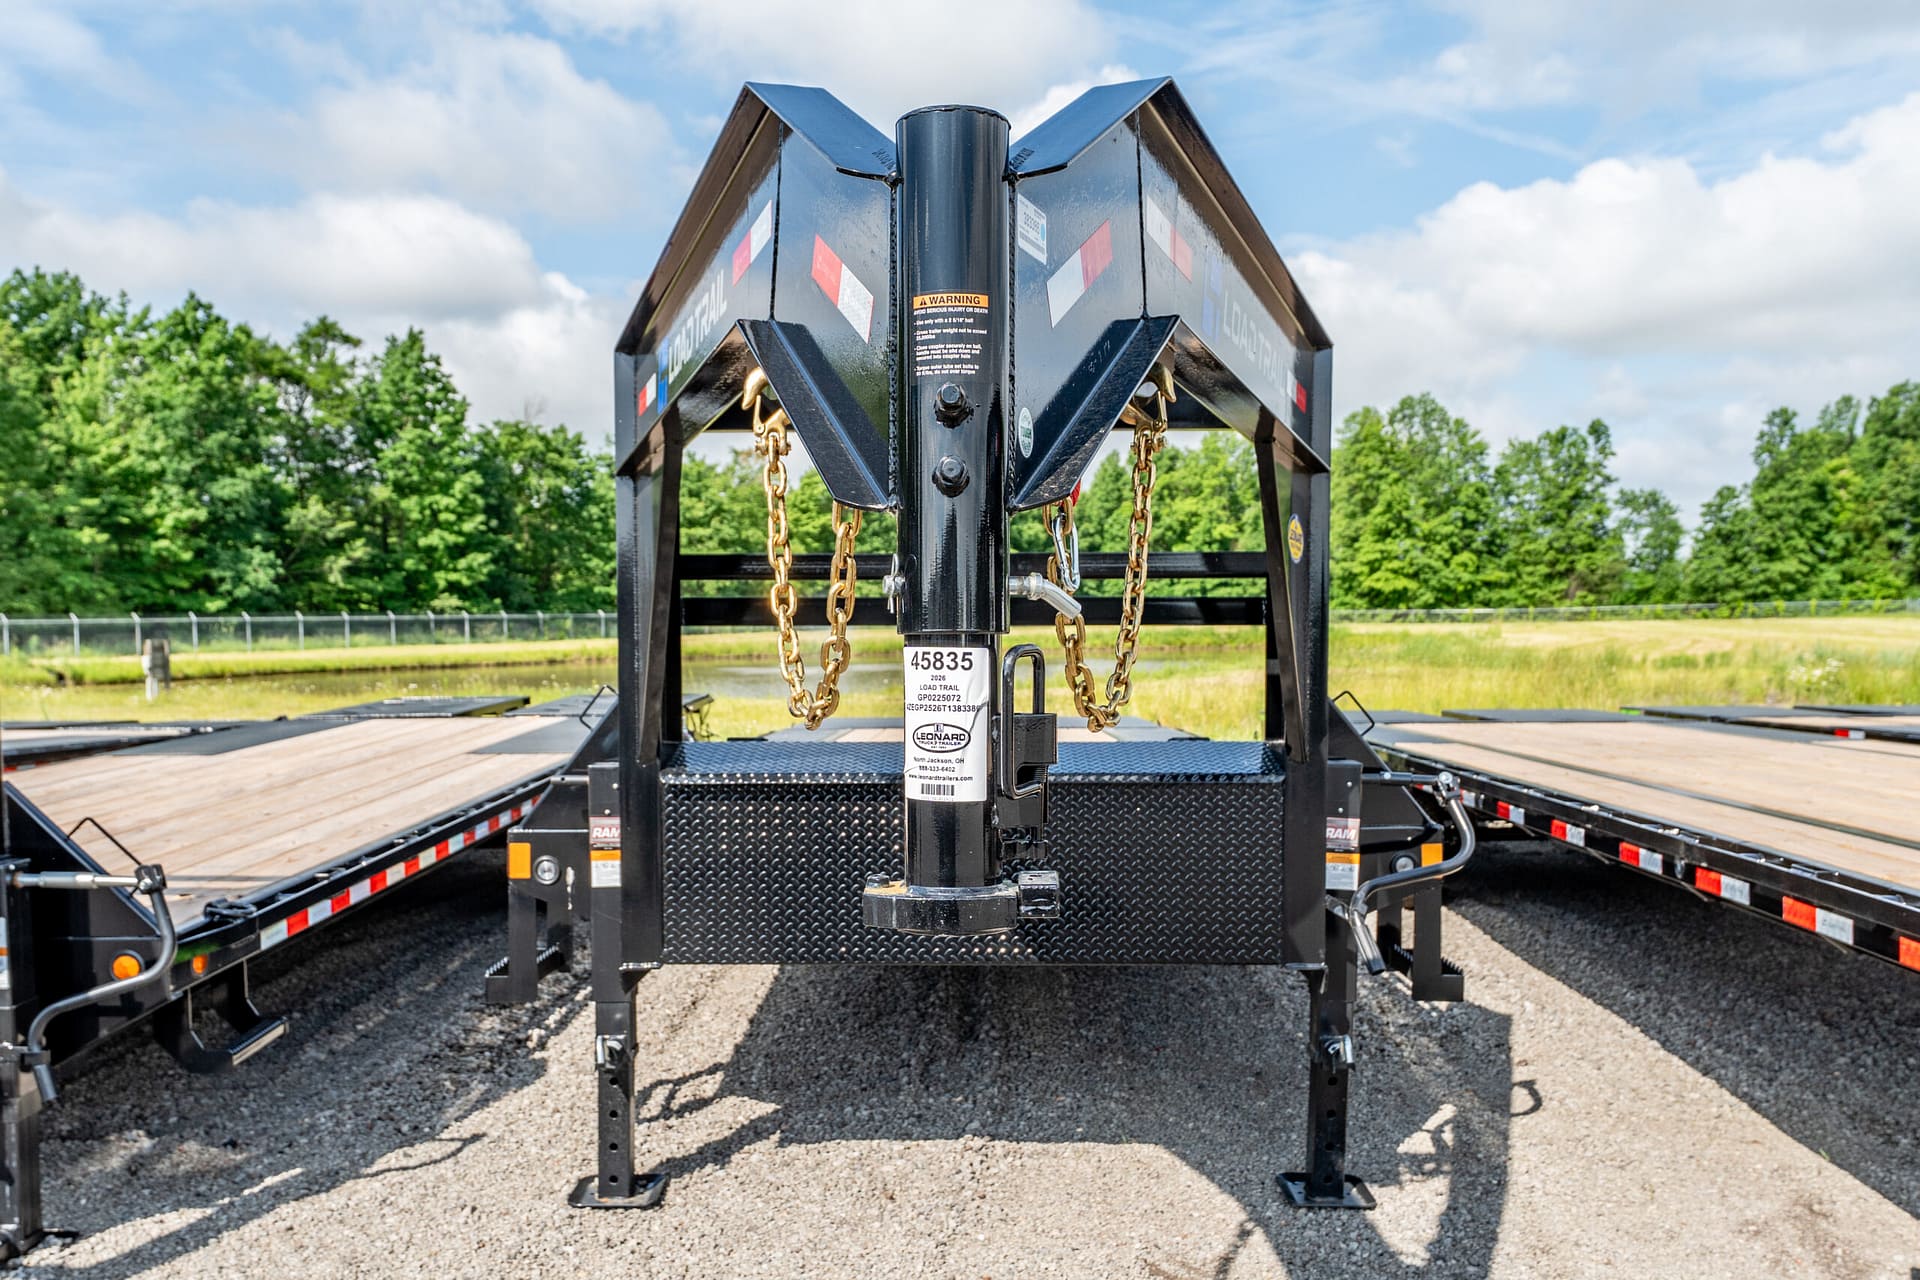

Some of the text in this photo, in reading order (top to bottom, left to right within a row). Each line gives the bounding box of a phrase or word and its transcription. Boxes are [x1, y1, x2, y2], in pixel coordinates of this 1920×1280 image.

[928, 295, 980, 305] WARNING
[911, 650, 973, 670] 45835
[918, 694, 962, 702] GP0225072
[916, 732, 966, 741] LEONARD
[592, 827, 620, 838] RAM
[1326, 827, 1356, 839] RAM
